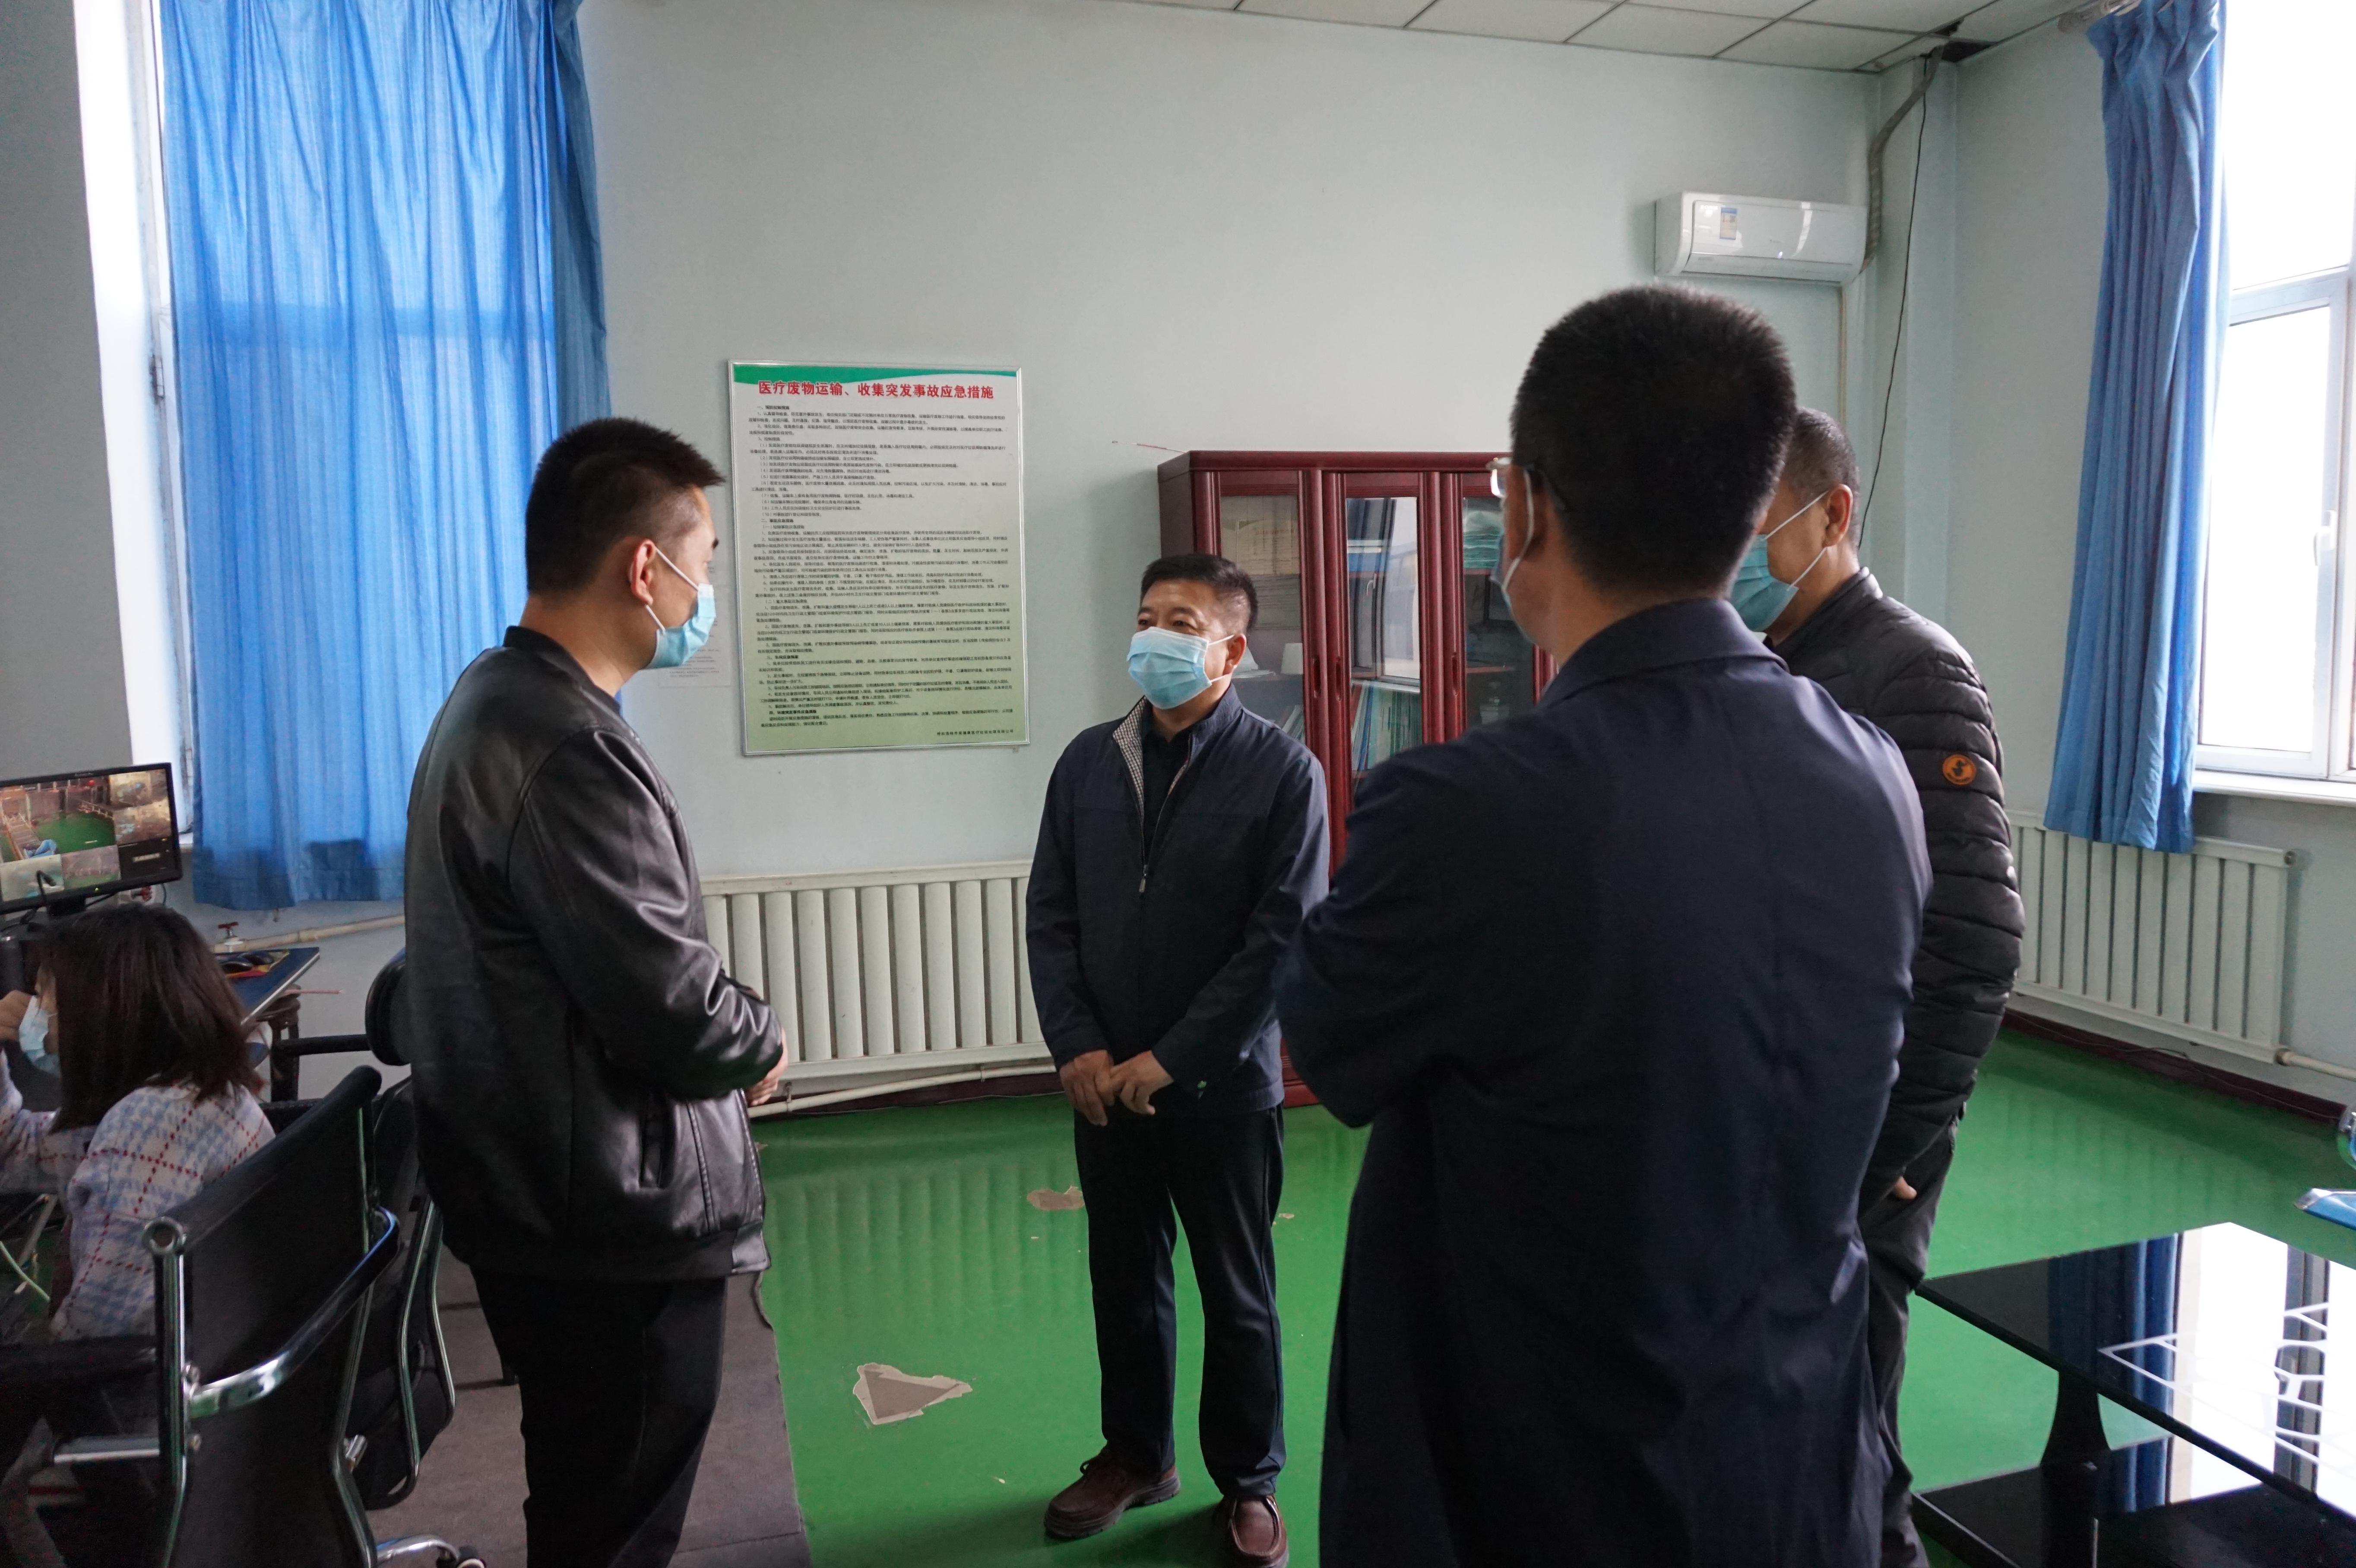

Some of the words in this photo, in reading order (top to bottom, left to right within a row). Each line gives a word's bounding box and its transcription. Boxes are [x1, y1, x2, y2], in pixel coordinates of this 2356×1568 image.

[758, 381, 994, 399] 医疗废物运输、收集突发事故应急措施
